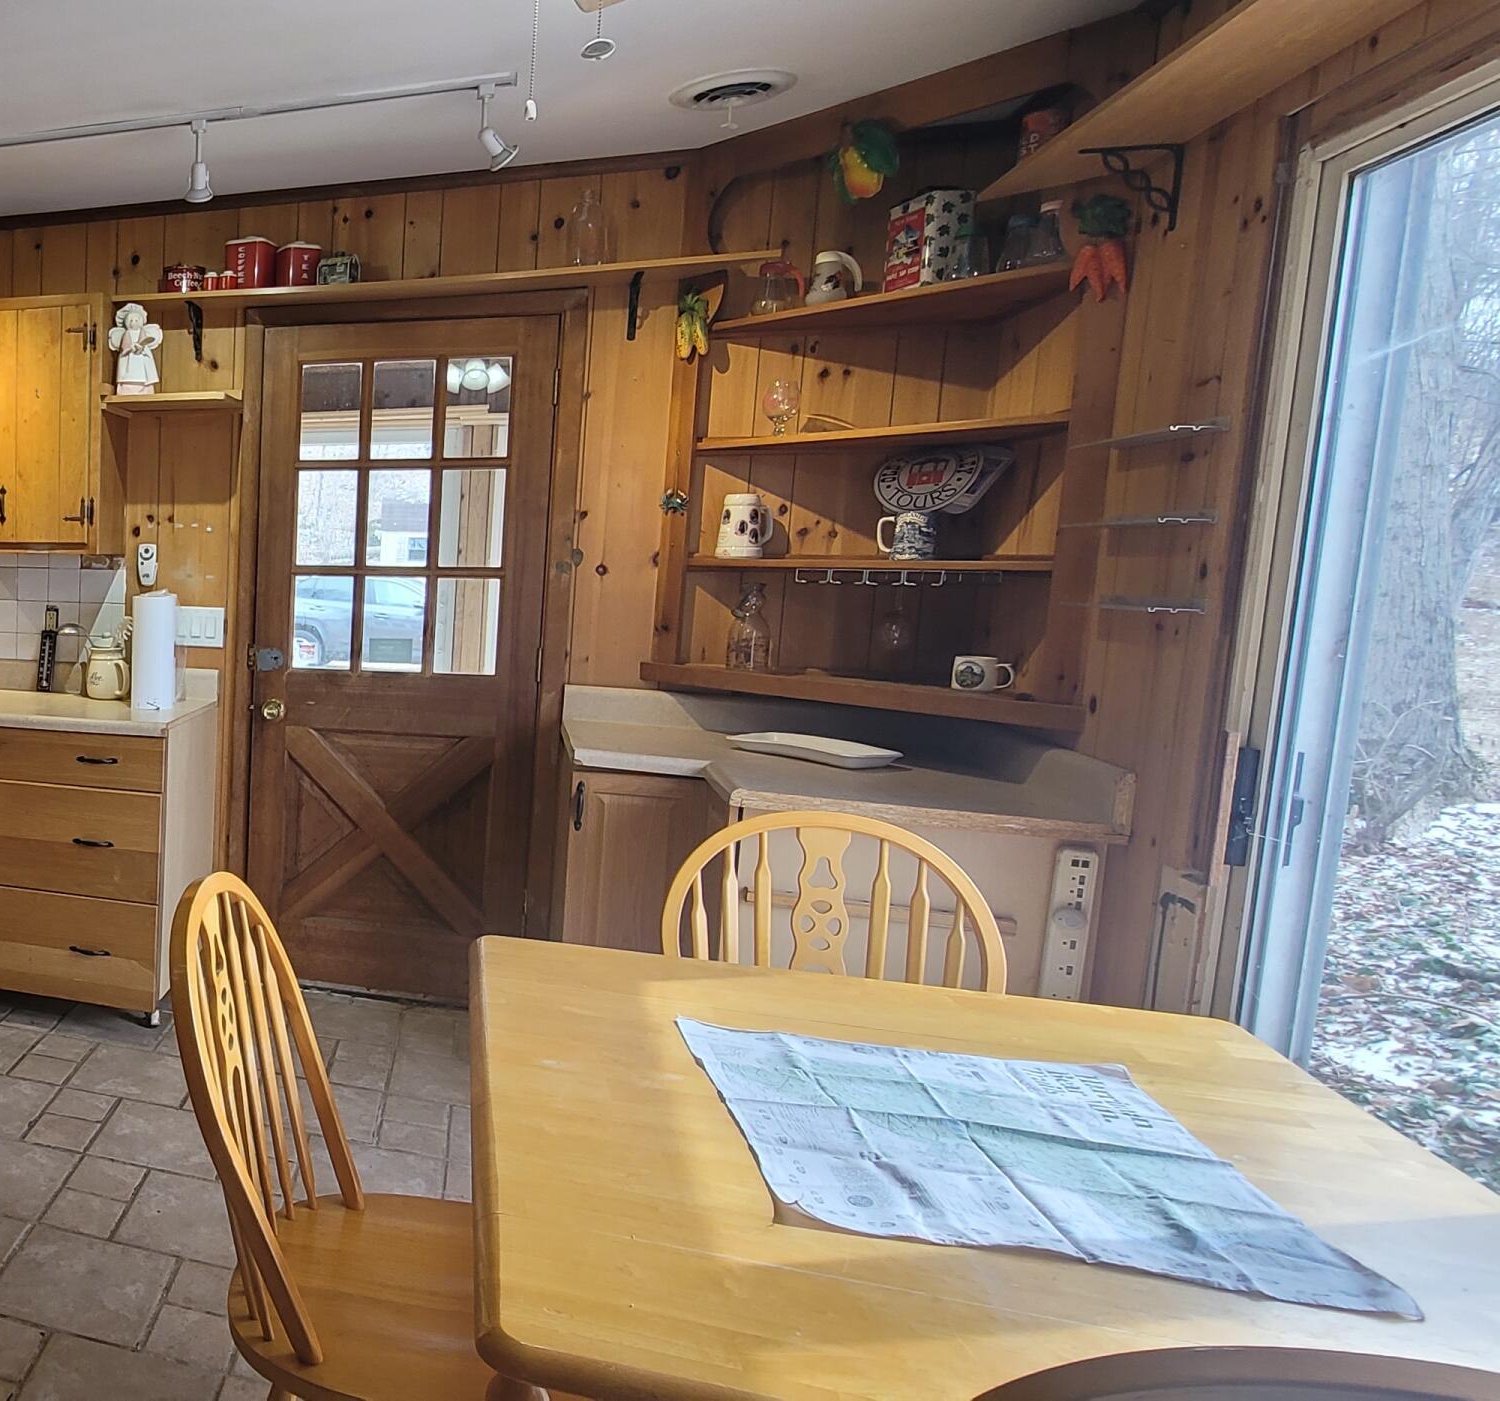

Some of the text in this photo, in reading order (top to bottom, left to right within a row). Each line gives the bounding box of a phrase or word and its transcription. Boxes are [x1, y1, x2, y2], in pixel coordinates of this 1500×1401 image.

[237, 246, 246, 284] COFFEE
[300, 254, 310, 279] TEA
[173, 279, 199, 288] Cofee
[888, 483, 958, 508] TOURS
